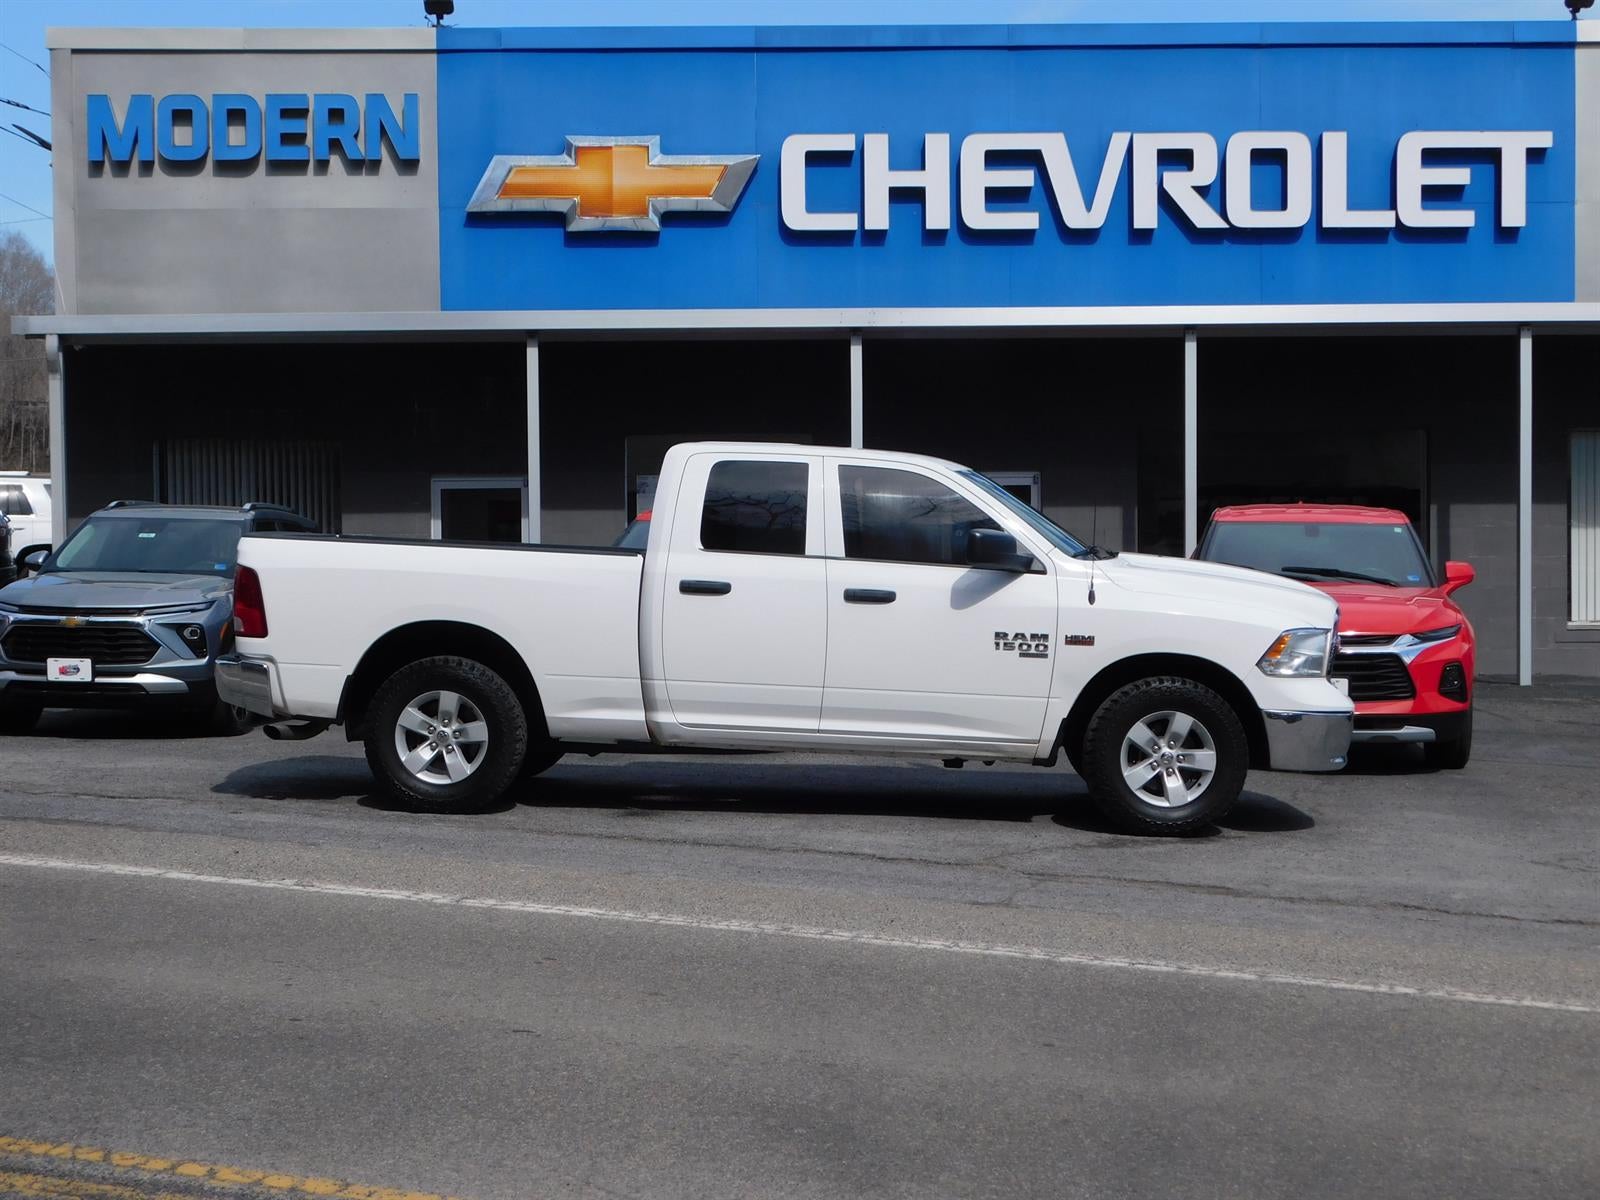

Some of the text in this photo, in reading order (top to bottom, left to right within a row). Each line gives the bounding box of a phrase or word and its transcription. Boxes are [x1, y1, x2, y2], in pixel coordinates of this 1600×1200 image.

[87, 93, 420, 163] MODERN
[780, 131, 1553, 231] CHEVROLET
[994, 632, 1049, 642] RAM
[994, 641, 1049, 652] 1500
